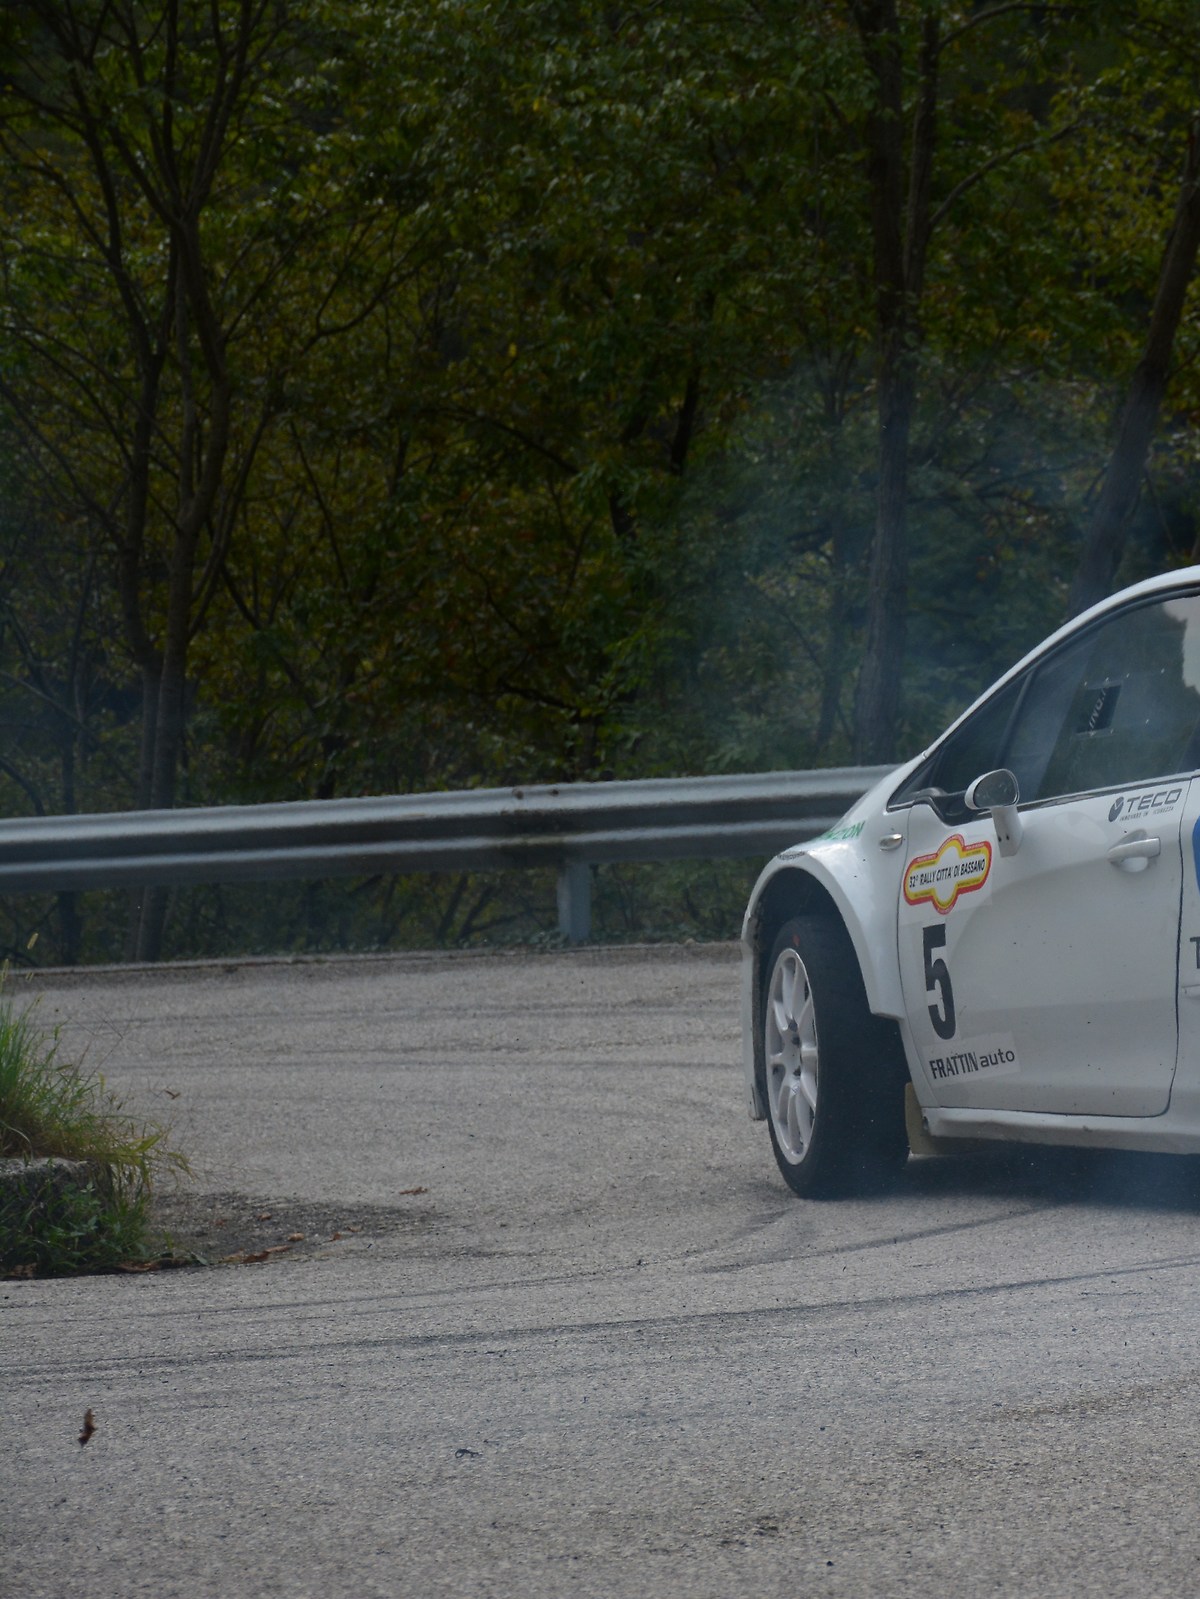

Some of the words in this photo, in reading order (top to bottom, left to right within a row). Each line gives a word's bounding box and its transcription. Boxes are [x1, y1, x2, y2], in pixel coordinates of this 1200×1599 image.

[1127, 788, 1182, 813] TECO
[920, 871, 936, 886] RALLY
[960, 858, 986, 876] BASSANO
[923, 923, 956, 1040] 5
[929, 1052, 979, 1080] FRATTIN
[980, 1049, 1015, 1068] auto
